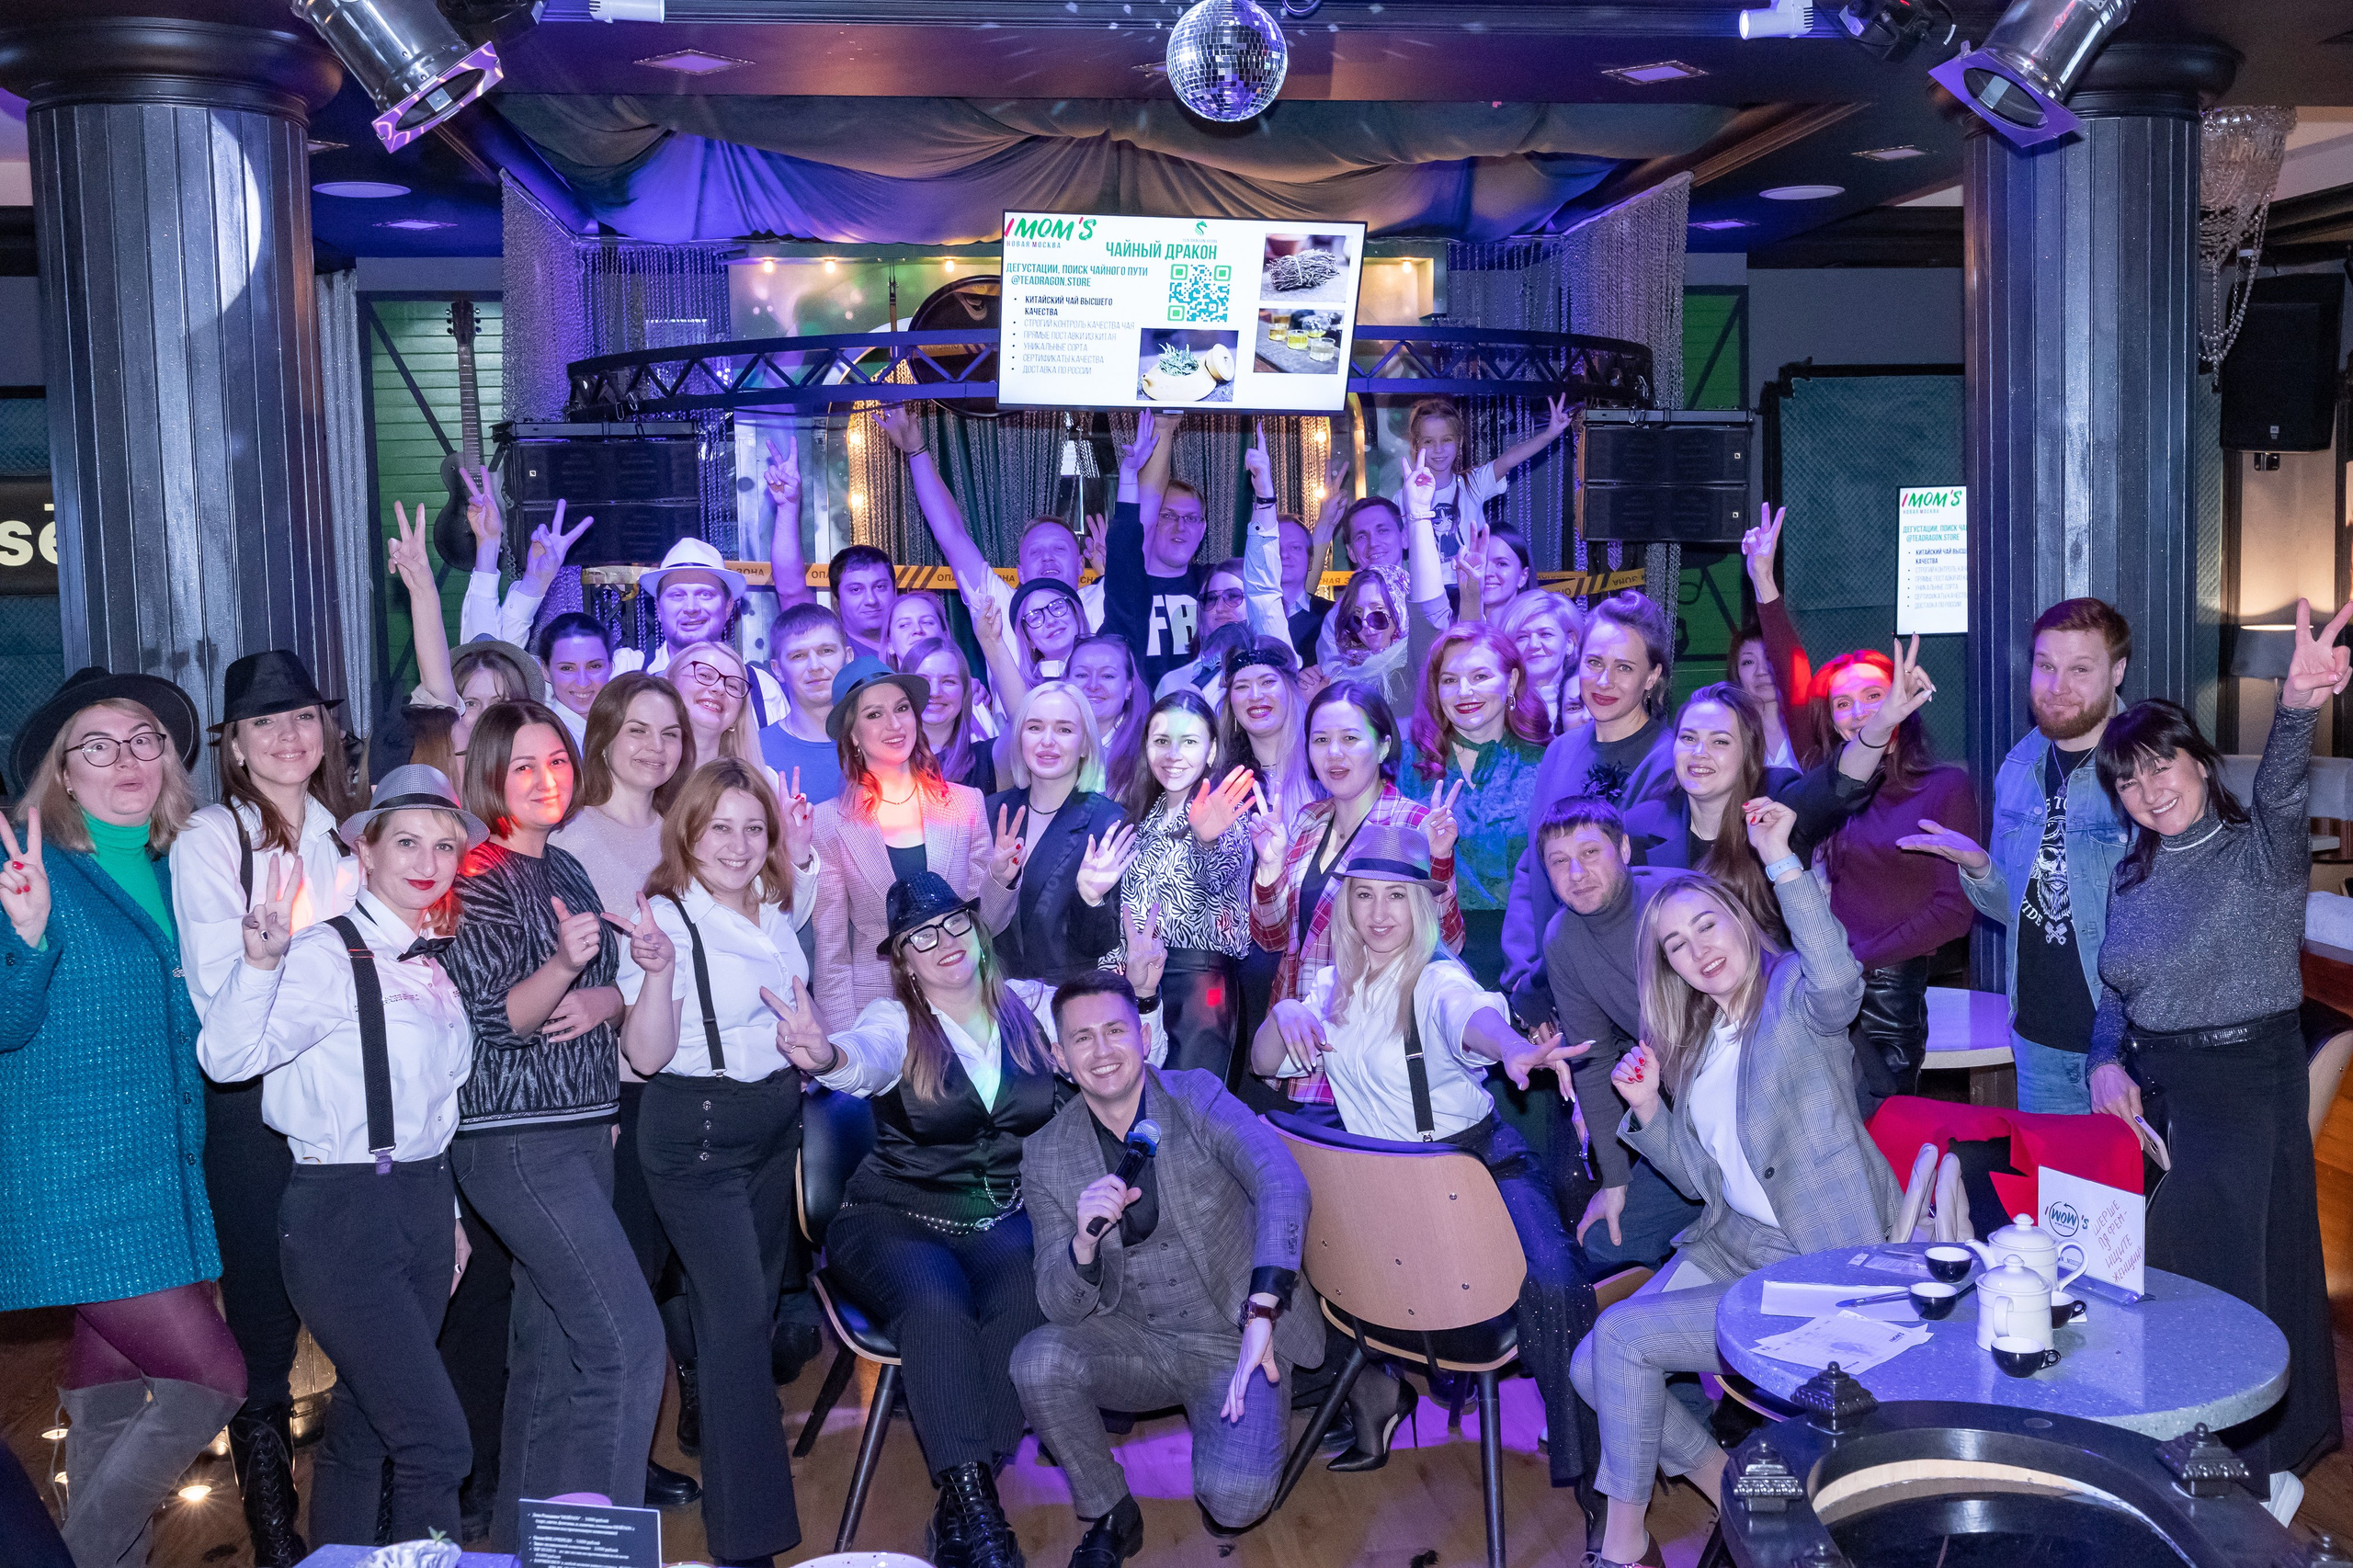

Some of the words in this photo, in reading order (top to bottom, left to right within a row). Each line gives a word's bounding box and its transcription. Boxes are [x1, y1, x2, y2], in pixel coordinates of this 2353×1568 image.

[1106, 239, 1162, 258] ЧАЙНЫЙ
[1165, 244, 1217, 260] ДРАКОН
[1006, 263, 1060, 274] ДЕГУСТАЦИИ,
[1063, 265, 1088, 274] ПОИСК
[1090, 264, 1126, 276] ЧАЙНОГО
[1128, 267, 1148, 276] ПУТИ
[1011, 275, 1091, 287] @TEADRAGON.STORE
[1026, 295, 1064, 304] КИТАЙСКИЙ
[1066, 296, 1079, 305] ЧАЙ
[1080, 298, 1112, 306] ВЫСШЕГО
[1024, 307, 1058, 316] КАЧЕСТВА
[1024, 318, 1053, 327] СТРОГИЙ
[1053, 320, 1086, 329] КОНТРОЛЬ
[1087, 321, 1120, 329] КАЧЕСТВА
[1024, 342, 1066, 351] УНИКАЛЬНЫЕ
[2052, 1208, 2077, 1226] WOW
